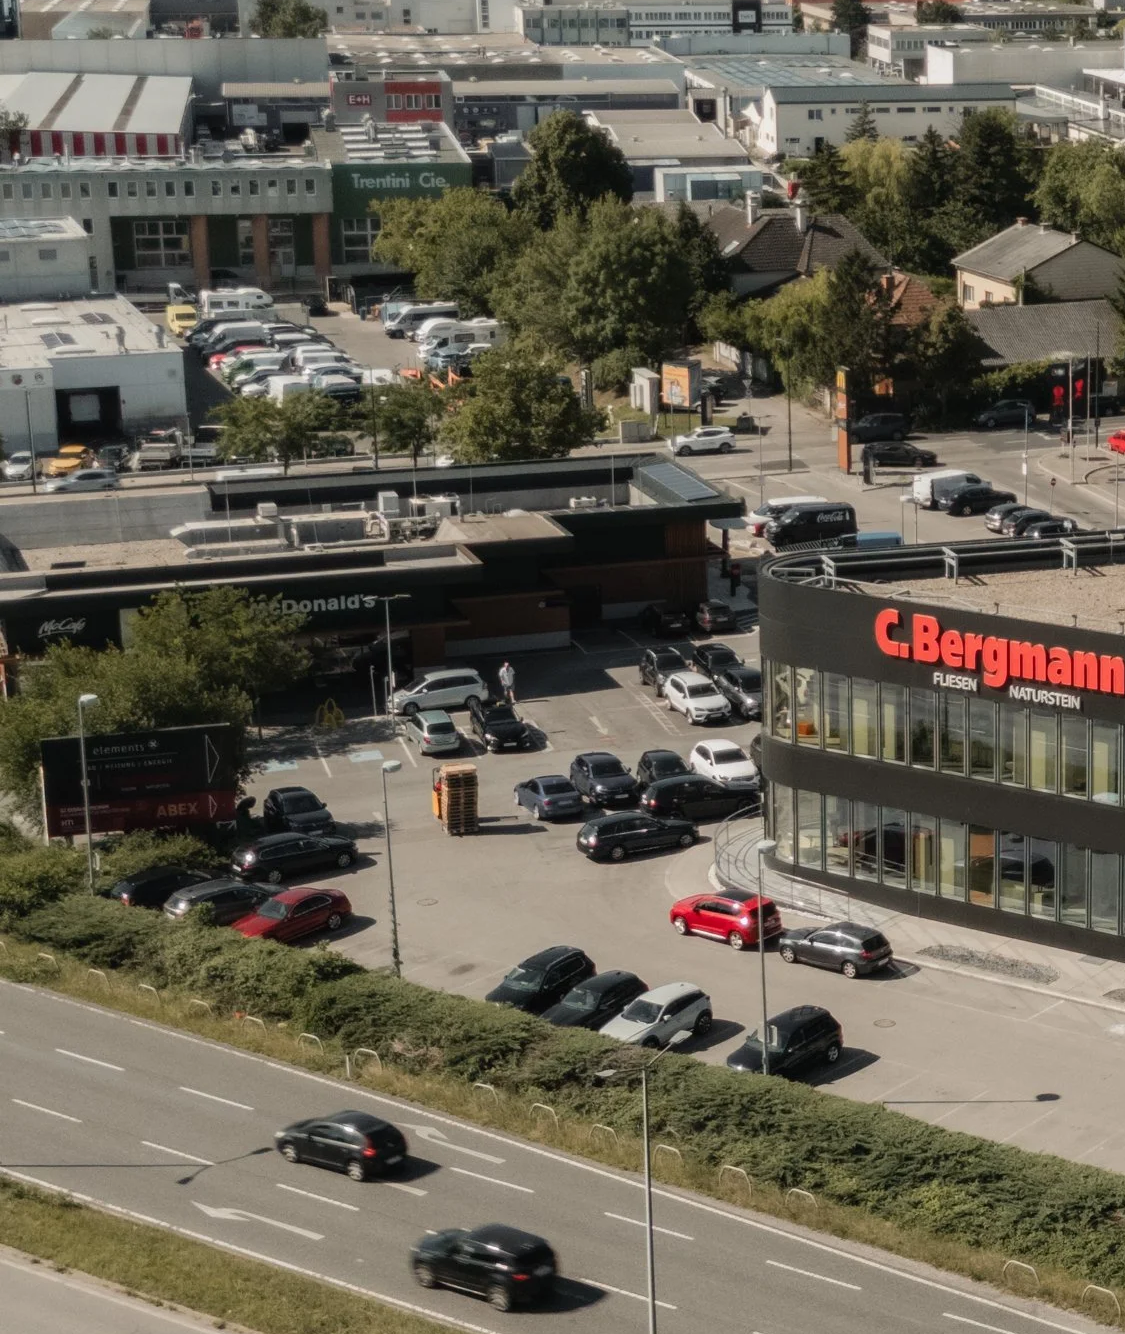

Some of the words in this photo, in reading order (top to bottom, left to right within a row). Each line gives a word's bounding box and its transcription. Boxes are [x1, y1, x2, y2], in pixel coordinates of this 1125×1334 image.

[352, 173, 410, 188] Trentini
[419, 172, 450, 187] Cie.
[874, 608, 1125, 695] C.Bergmann
[933, 672, 978, 692] FLIESEN
[1009, 685, 1081, 710] NATURSTEIN
[93, 743, 145, 756] elements
[157, 802, 199, 817] ABEX
